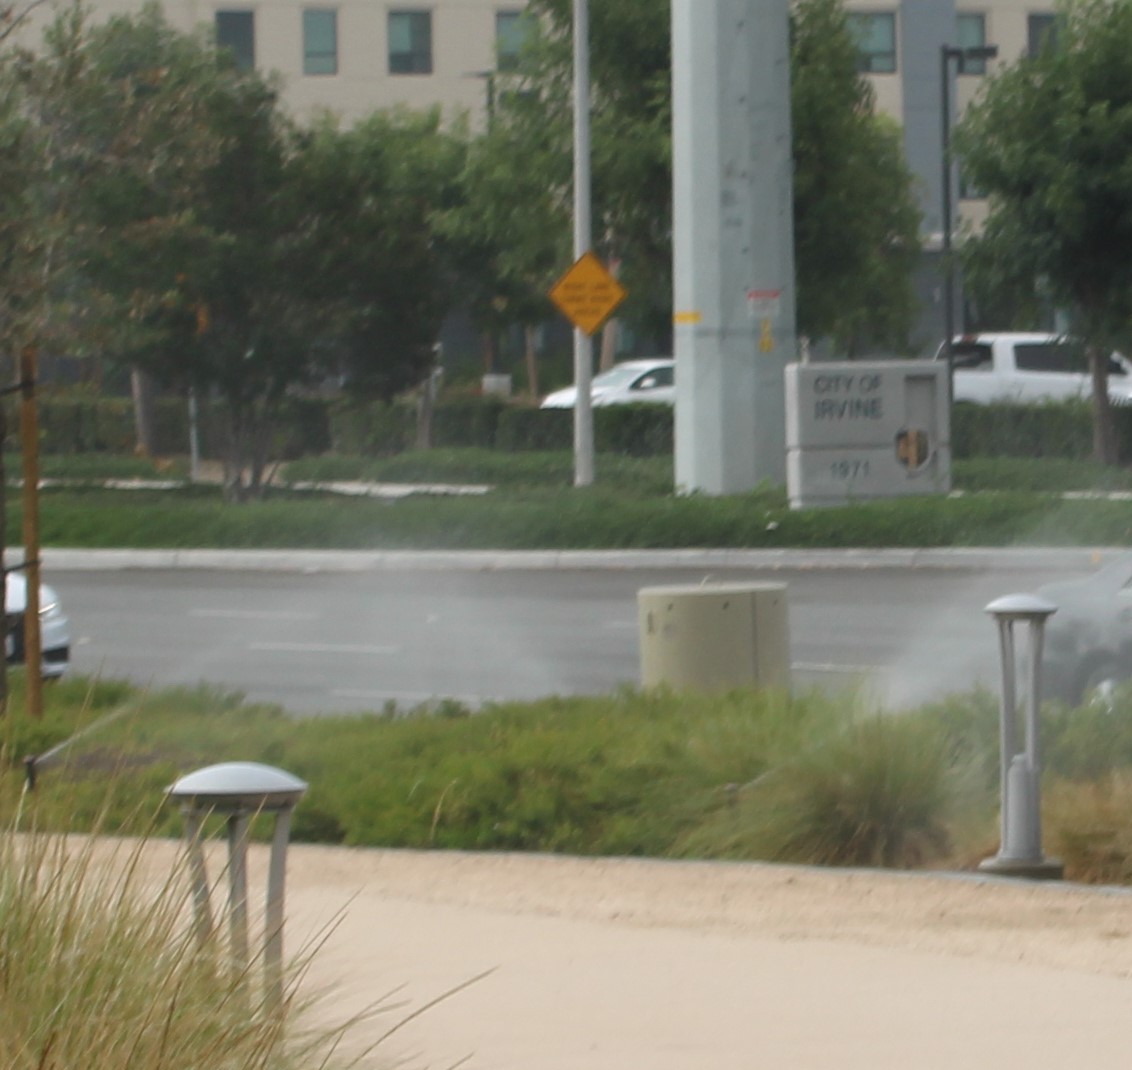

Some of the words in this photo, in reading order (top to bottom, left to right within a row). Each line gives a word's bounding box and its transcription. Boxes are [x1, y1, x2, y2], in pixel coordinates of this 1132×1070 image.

[814, 375, 854, 393] CITY
[860, 374, 882, 393] OF
[814, 398, 883, 420] IRVINE
[831, 460, 870, 479] 1971
